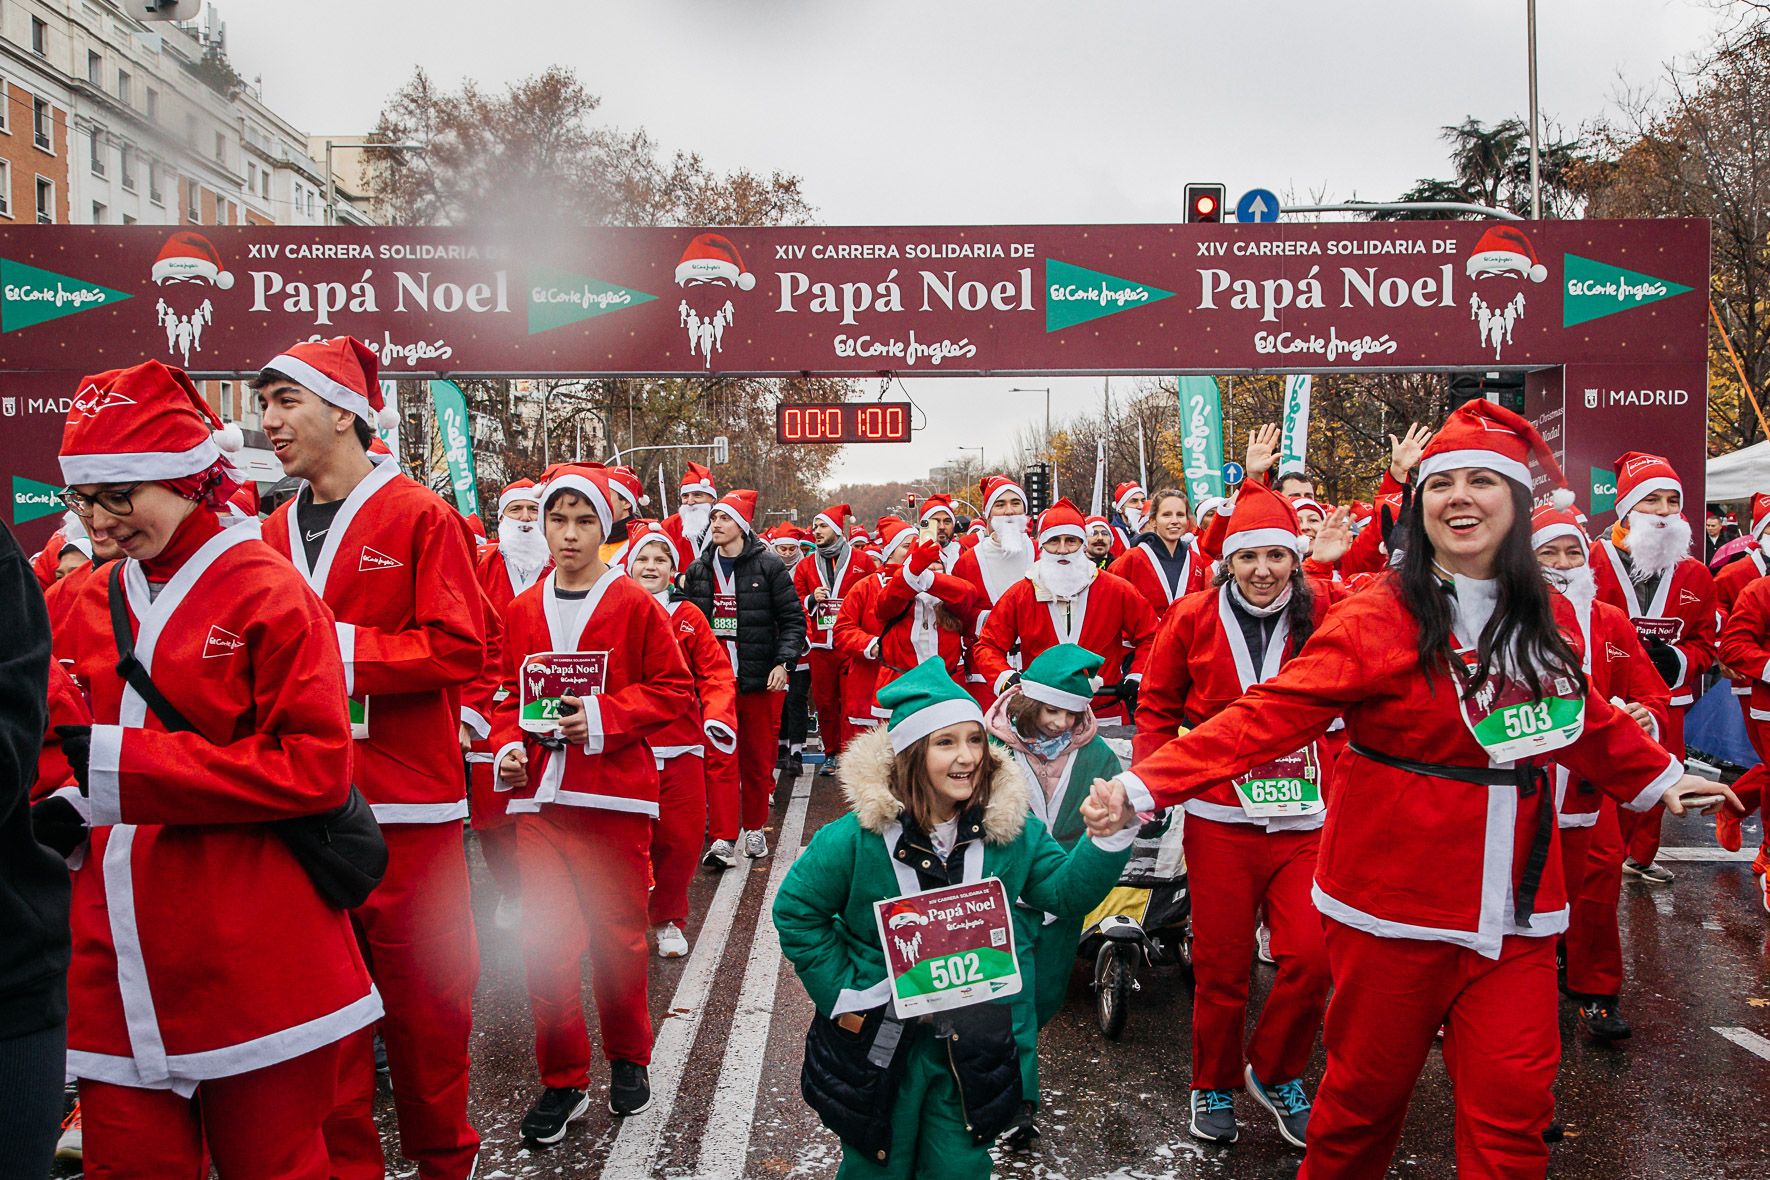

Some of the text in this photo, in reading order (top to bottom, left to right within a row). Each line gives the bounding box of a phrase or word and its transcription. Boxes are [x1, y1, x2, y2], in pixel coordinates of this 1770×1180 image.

[248, 244, 280, 258] XIV
[285, 244, 374, 259] CARRERA
[379, 244, 480, 260] SOLIDARIA
[776, 244, 1034, 259] XIV CARRERA SOLIDARIA DE
[1196, 240, 1456, 256] XIV CARRERA SOLIDARIA DE
[4, 282, 105, 307] El Corte Inglés
[248, 268, 512, 326] Papá Noel
[532, 284, 631, 308] El Corte Inglés
[774, 267, 1036, 326] Papá Noel
[1050, 282, 1149, 306] El Corte Inglés
[1196, 264, 1457, 322] Papá Noel
[1568, 276, 1667, 301] El Corte Inglés
[382, 331, 452, 366] Inglés
[834, 330, 976, 365] El Corte Inglés
[1254, 326, 1397, 362] El Corte Inglés
[28, 398, 73, 414] MAD
[1610, 390, 1688, 406] MADRID
[714, 618, 737, 629] 8838
[551, 664, 598, 676] Papá Noel
[542, 699, 560, 718] 22
[1504, 702, 1552, 737] 503
[1252, 780, 1302, 802] 6530
[928, 896, 996, 922] Papá Noel
[930, 952, 984, 989] 502
